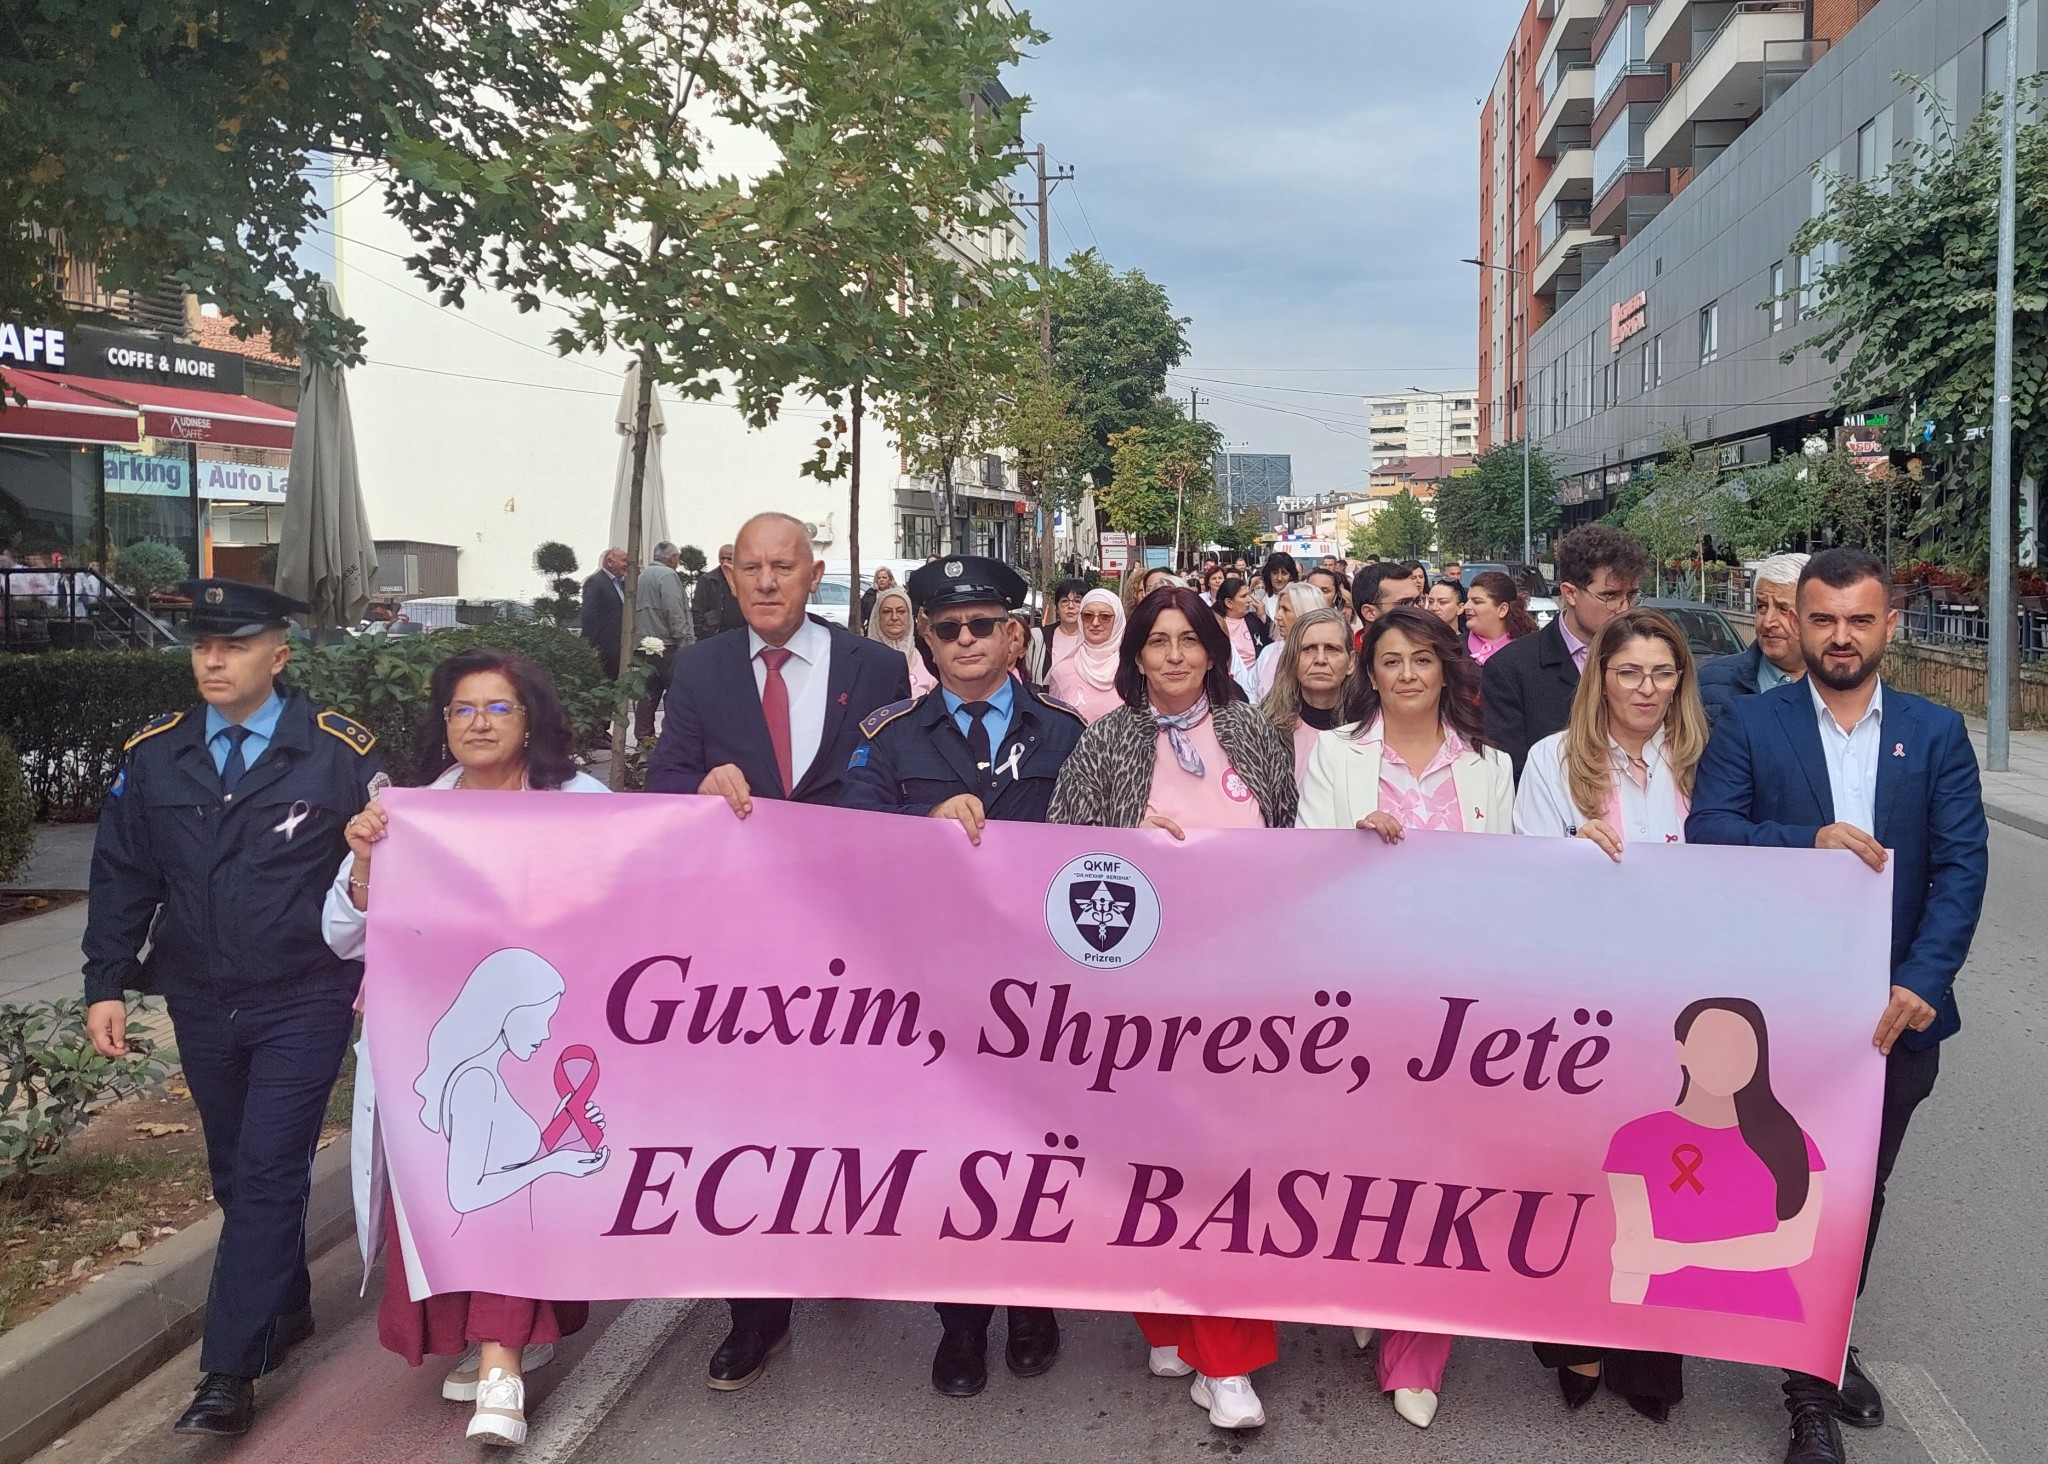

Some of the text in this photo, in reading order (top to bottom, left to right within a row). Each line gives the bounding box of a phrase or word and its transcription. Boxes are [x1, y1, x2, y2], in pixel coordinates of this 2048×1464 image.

[107, 347, 216, 378] COFFE & MORE
[208, 465, 262, 492] Auto
[1083, 860, 1122, 873] QKMF
[1084, 952, 1122, 963] Prizren
[605, 954, 1614, 1096] Guxim, Shpresë, Jetë
[600, 1131, 1596, 1280] ECIM SË BASHKU
